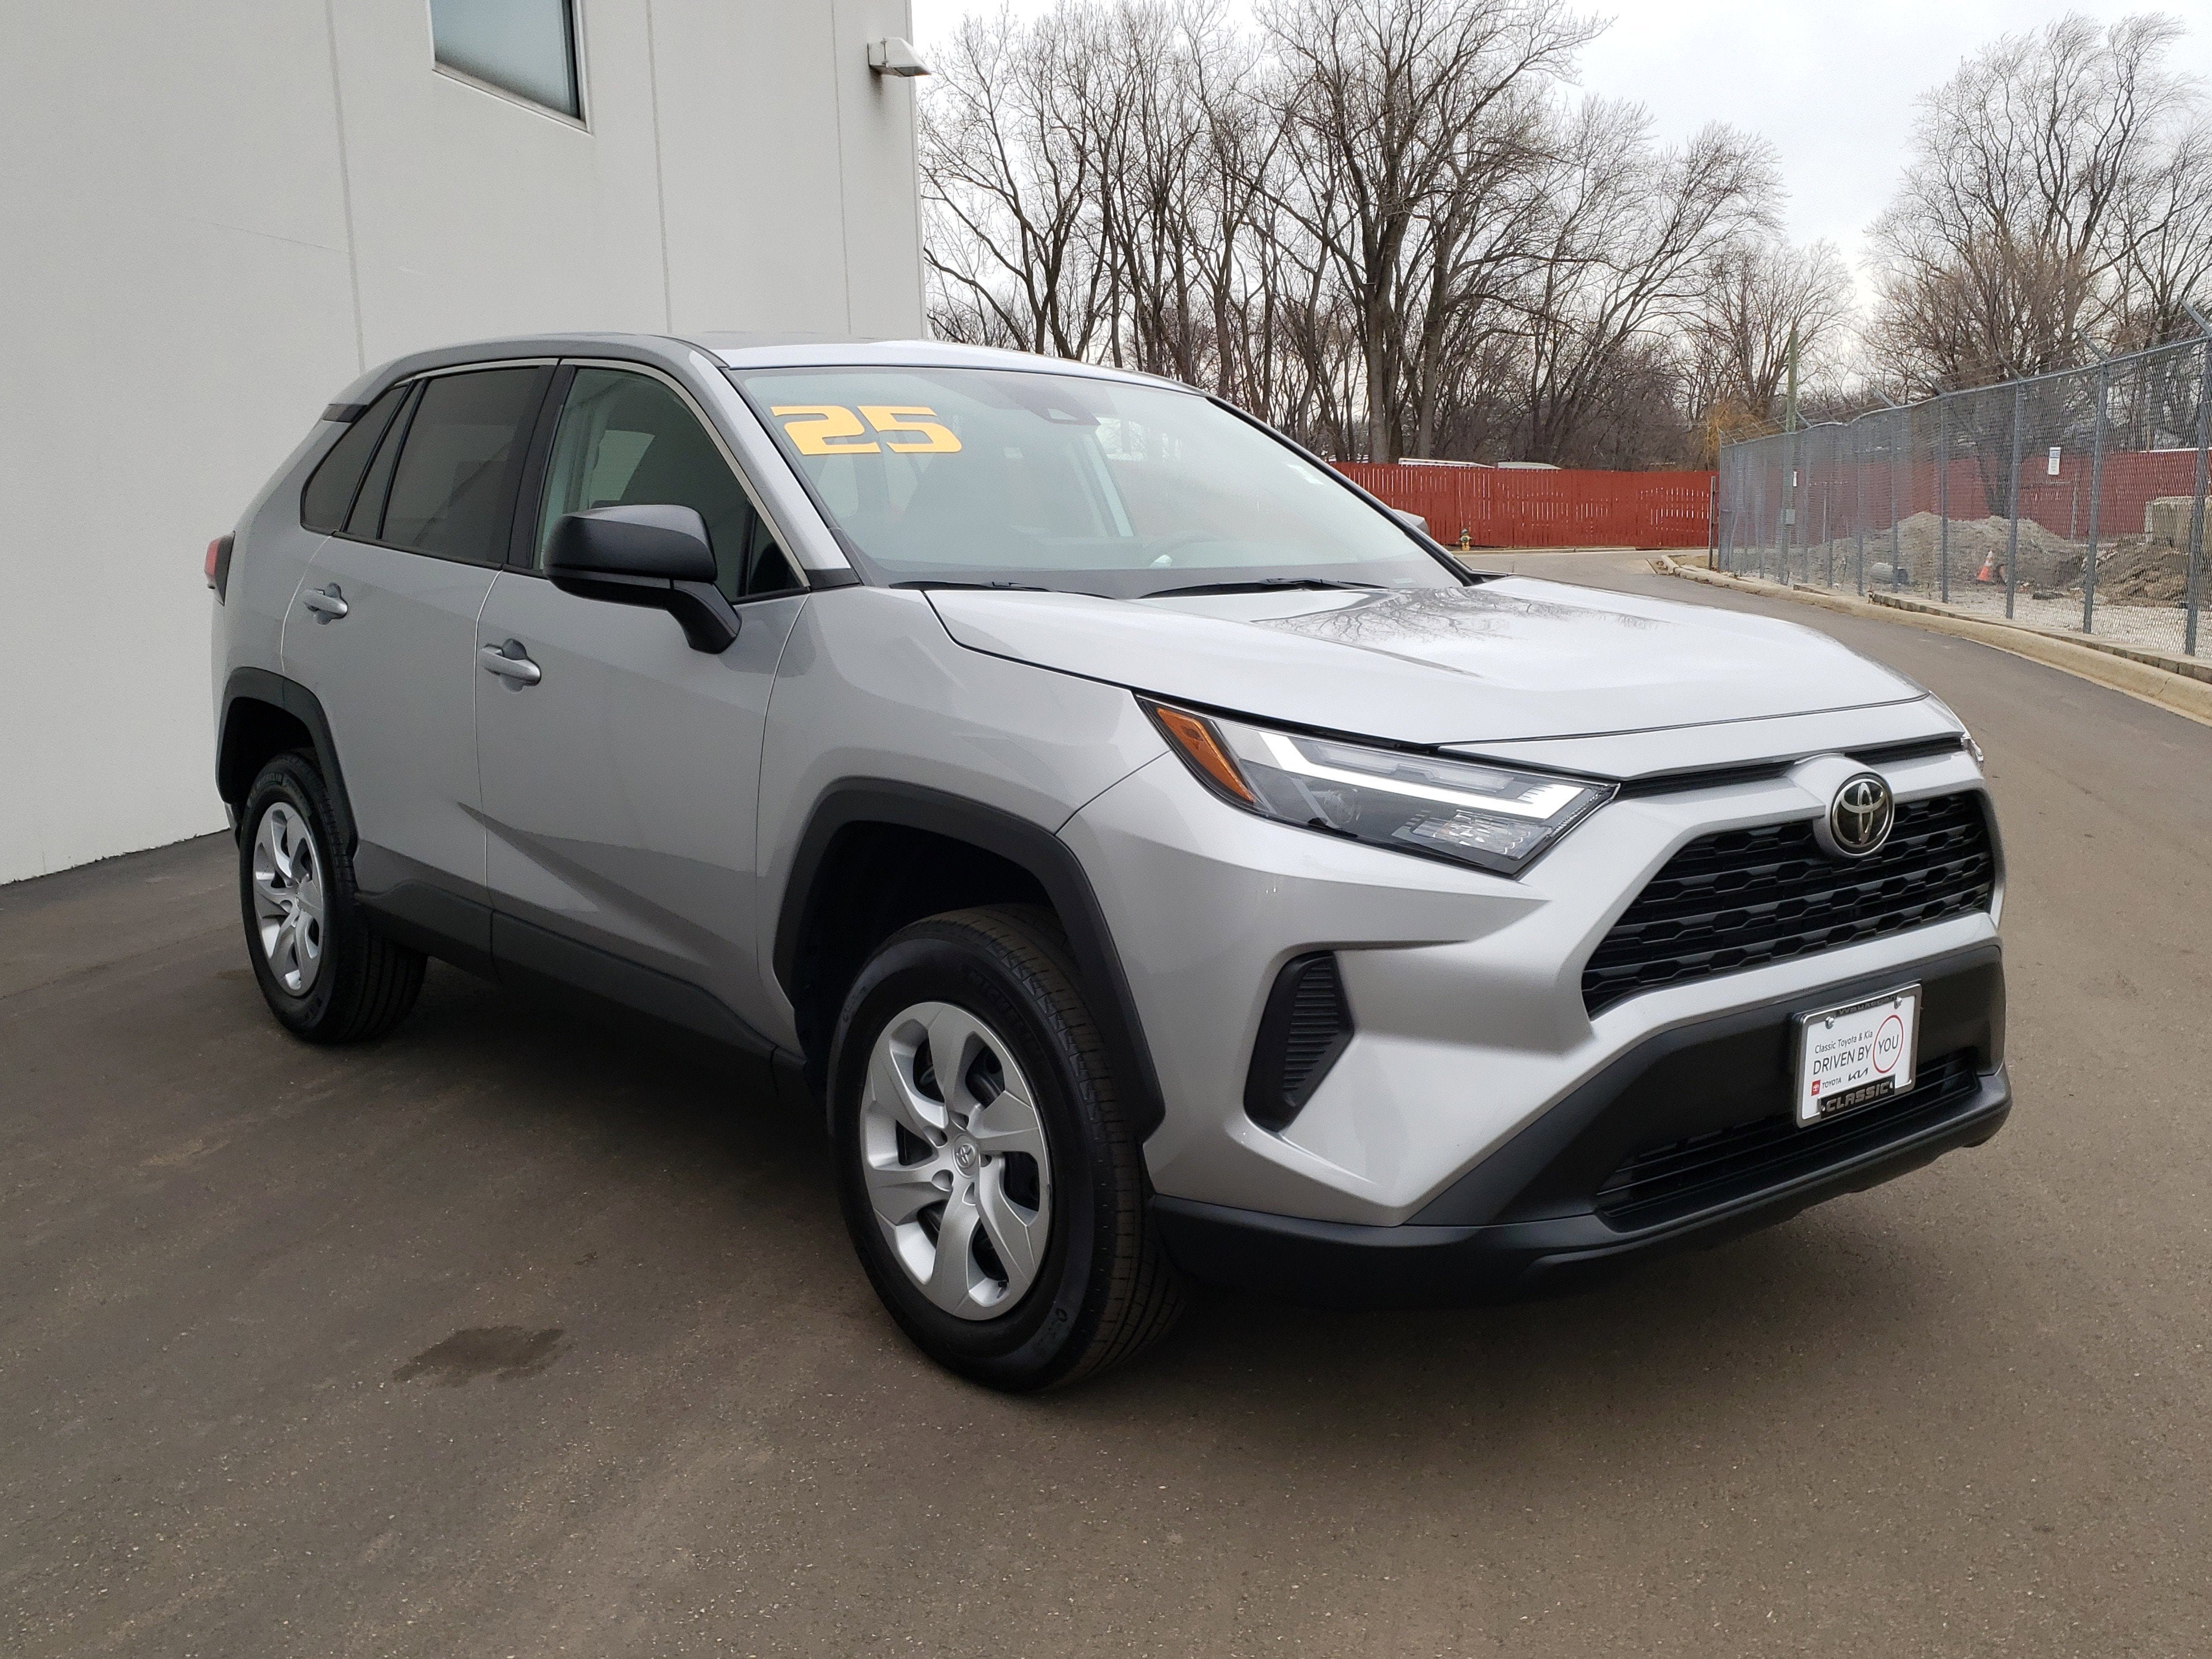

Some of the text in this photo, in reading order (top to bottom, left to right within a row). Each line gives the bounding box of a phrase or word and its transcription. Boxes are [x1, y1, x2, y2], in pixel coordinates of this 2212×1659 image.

[770, 405, 962, 455] 25
[1813, 1034, 1899, 1075] DRIVEN BY YOU
[1814, 1030, 1873, 1054] Classic Toyota & Kia
[1822, 1077, 1842, 1089] TOYOTA
[1826, 1081, 1890, 1113] CLASSIC
